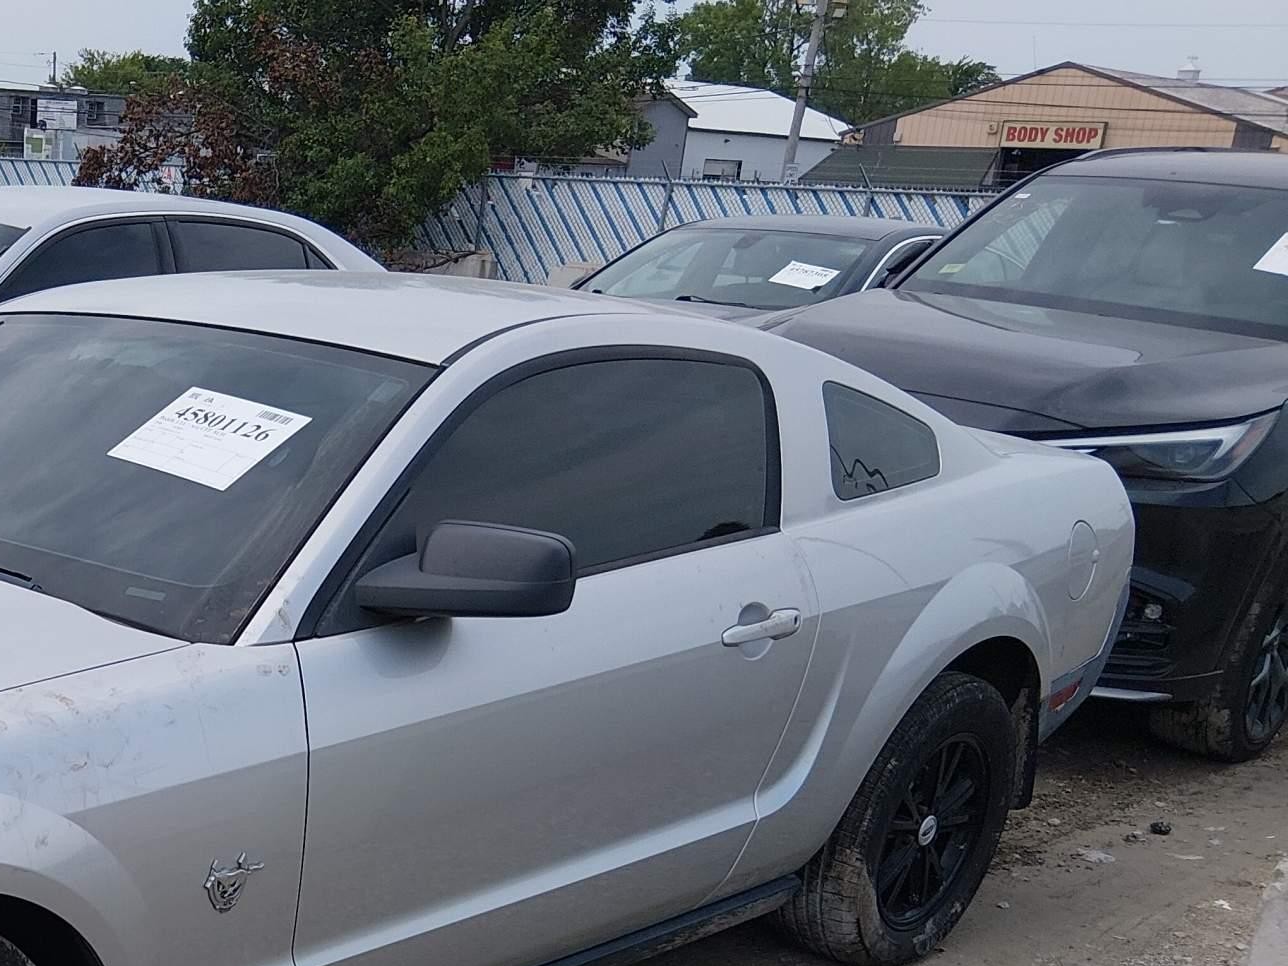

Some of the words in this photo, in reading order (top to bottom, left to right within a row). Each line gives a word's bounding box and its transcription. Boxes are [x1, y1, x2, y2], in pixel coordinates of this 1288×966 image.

[1005, 126, 1049, 142] BODY
[1052, 127, 1099, 144] SHOP
[176, 406, 277, 441] 45801126
